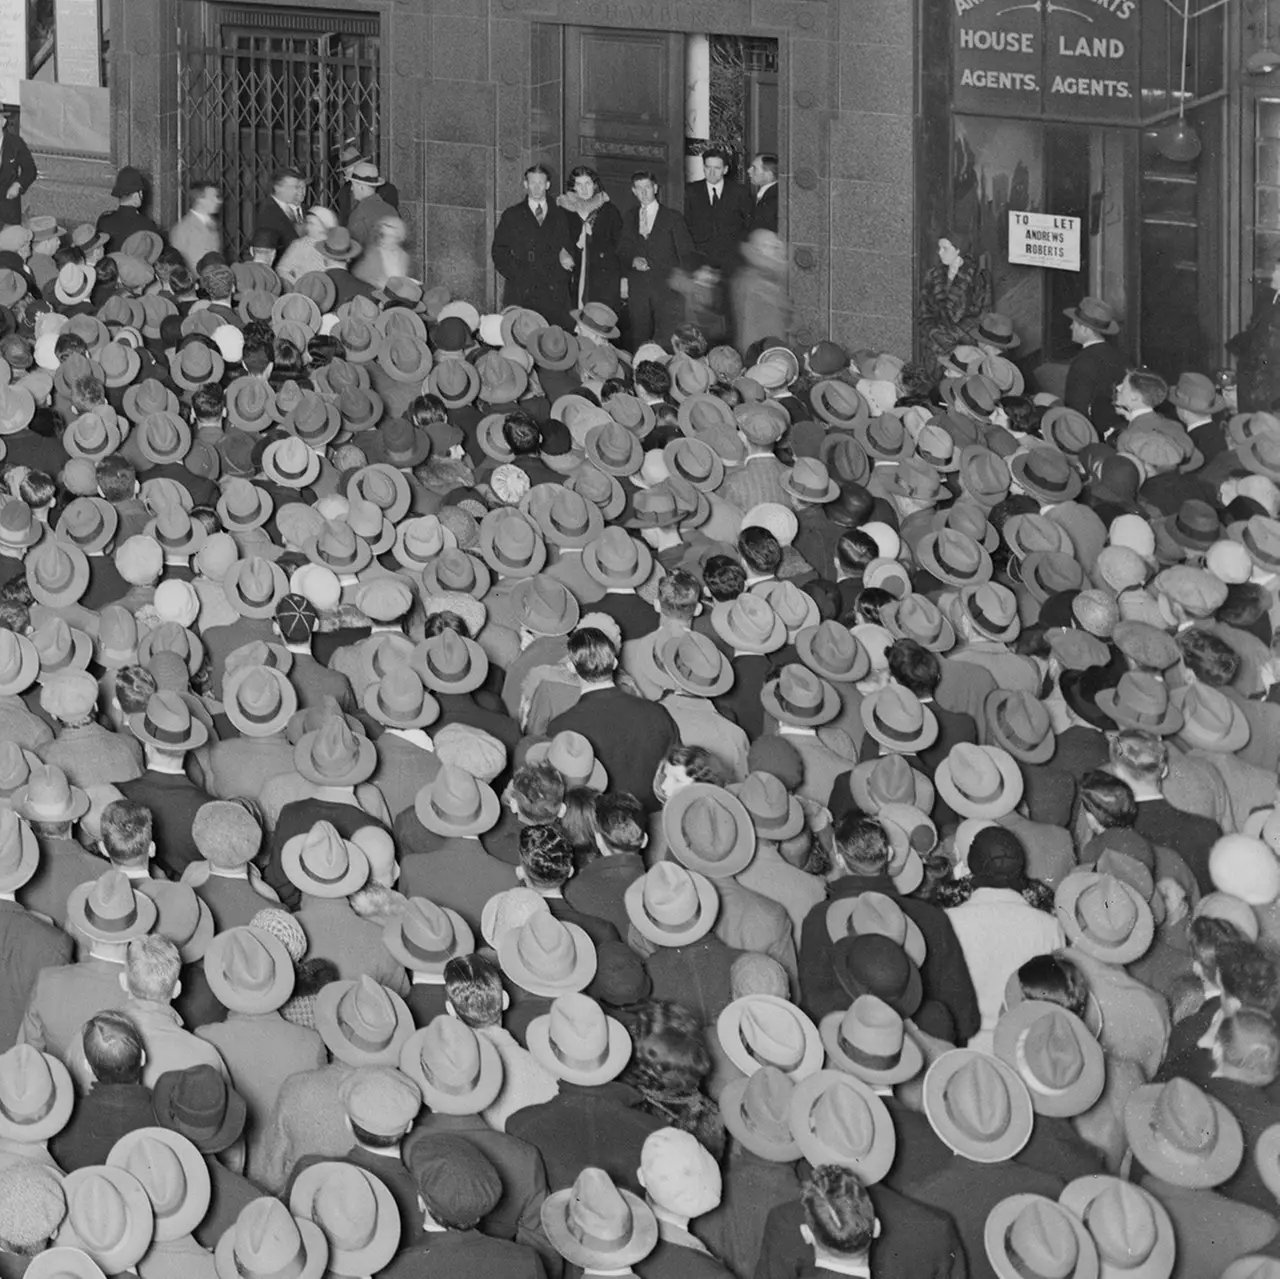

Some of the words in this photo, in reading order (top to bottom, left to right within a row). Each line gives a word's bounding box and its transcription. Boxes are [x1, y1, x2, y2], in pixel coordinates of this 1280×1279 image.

[960, 28, 1034, 53] HOUSE
[1059, 35, 1124, 59] LAND
[961, 68, 1040, 91] AGENTS.
[1051, 75, 1133, 98] AGENTS.
[1016, 215, 1028, 224] TO
[1055, 219, 1073, 228] LET
[1026, 244, 1063, 257] ROBERTS
